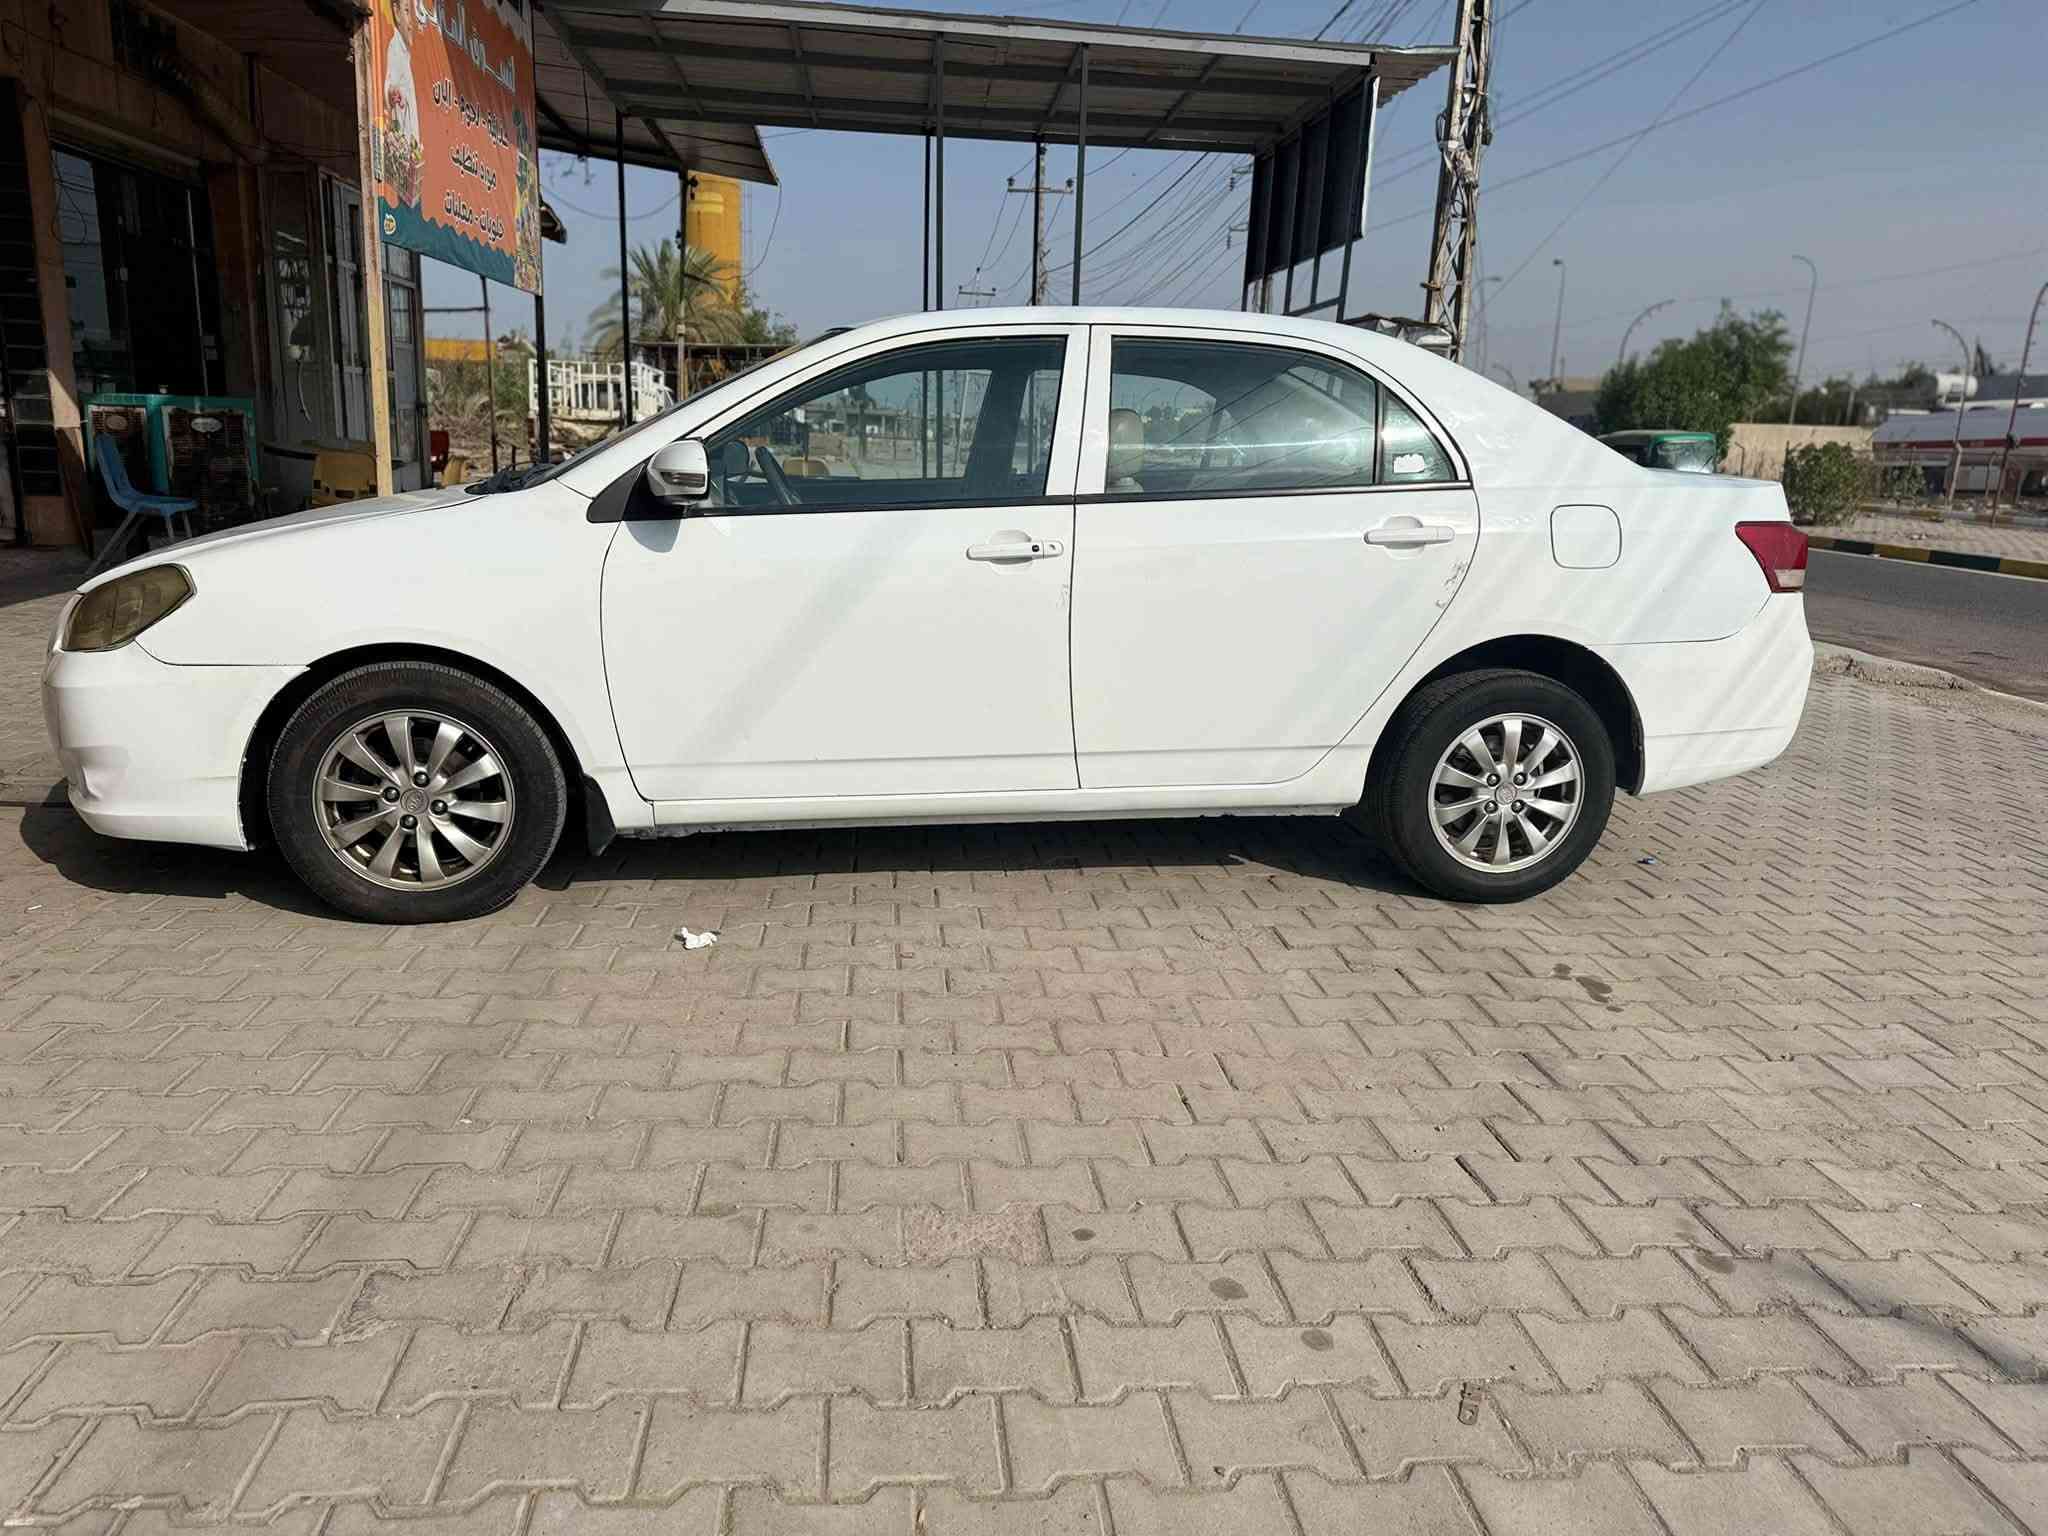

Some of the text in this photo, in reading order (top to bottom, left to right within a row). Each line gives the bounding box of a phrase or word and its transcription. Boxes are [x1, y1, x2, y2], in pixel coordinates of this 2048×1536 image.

[479, 161, 497, 192] مواد
[443, 190, 473, 226] معلبات
[479, 208, 504, 242] حلويات
